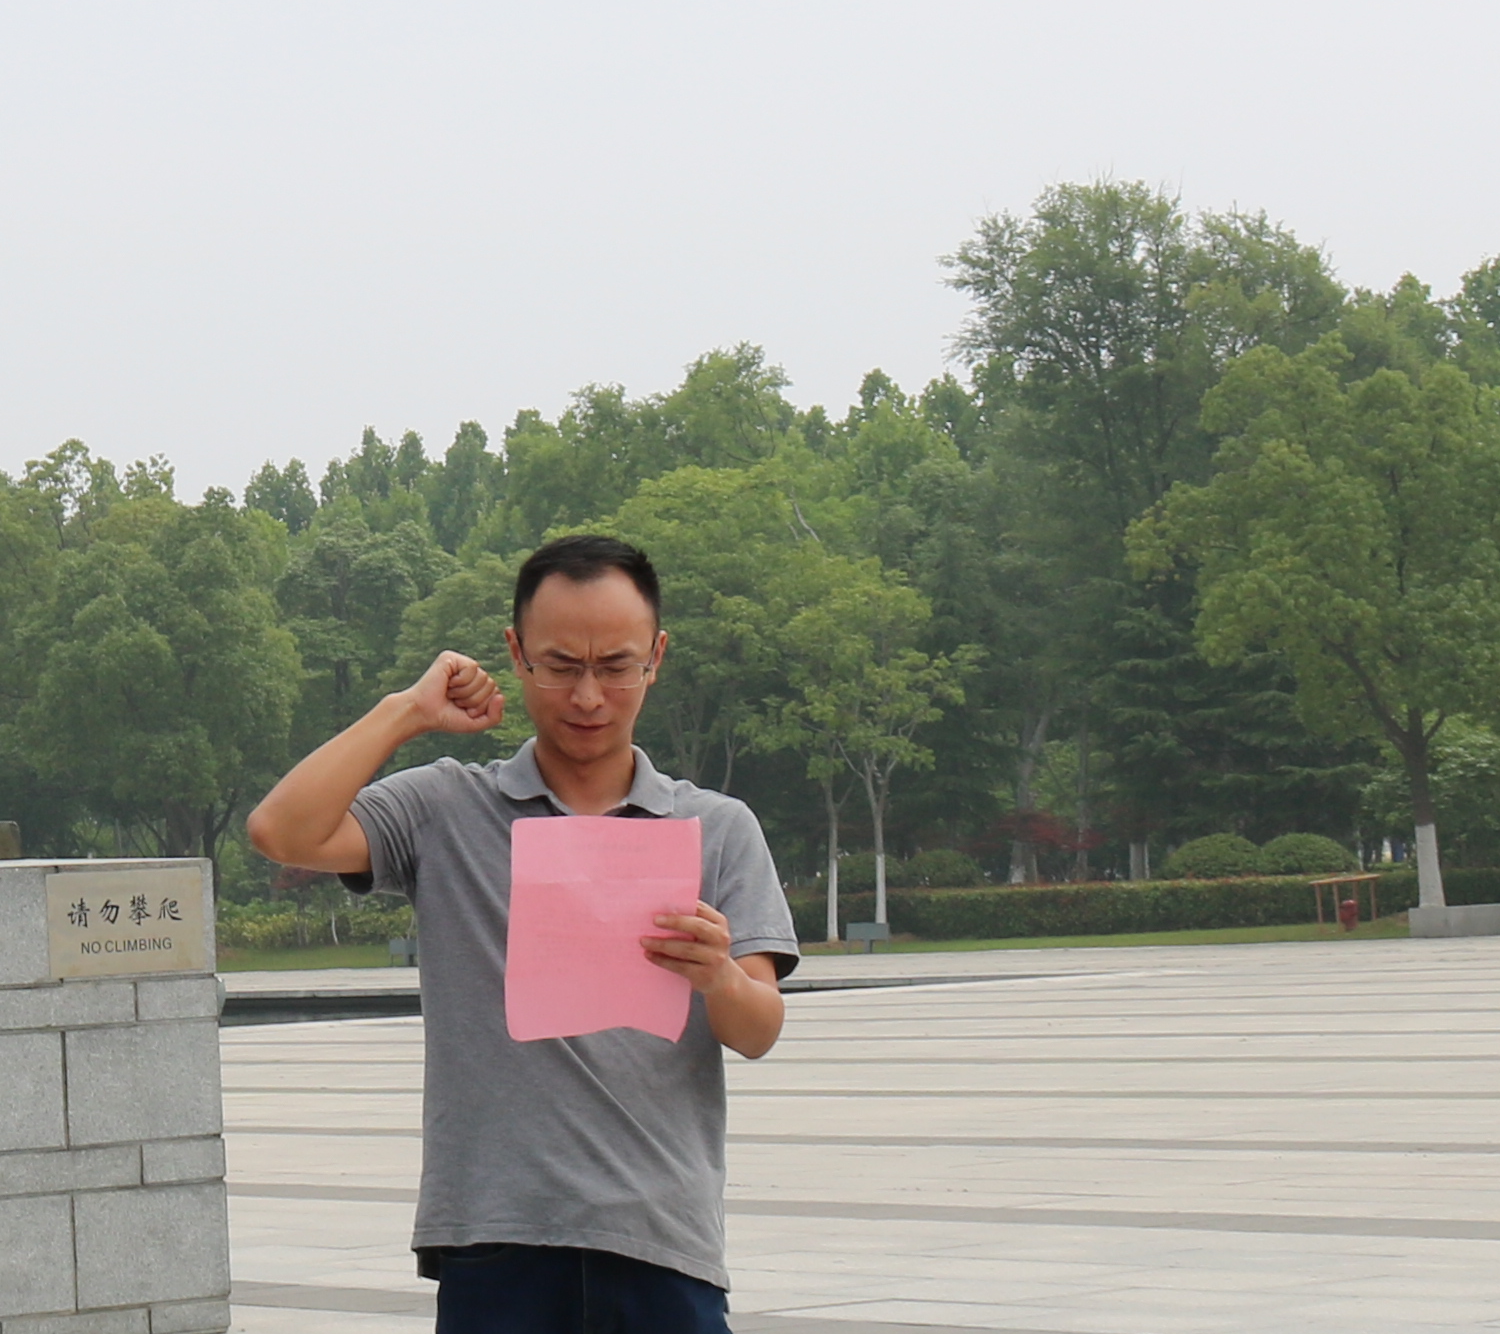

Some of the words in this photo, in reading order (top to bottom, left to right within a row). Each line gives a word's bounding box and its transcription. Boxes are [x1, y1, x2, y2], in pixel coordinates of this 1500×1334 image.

[67, 893, 183, 928] 请勿攀爬
[81, 940, 101, 954] NO
[104, 937, 173, 953] CLIMBING
